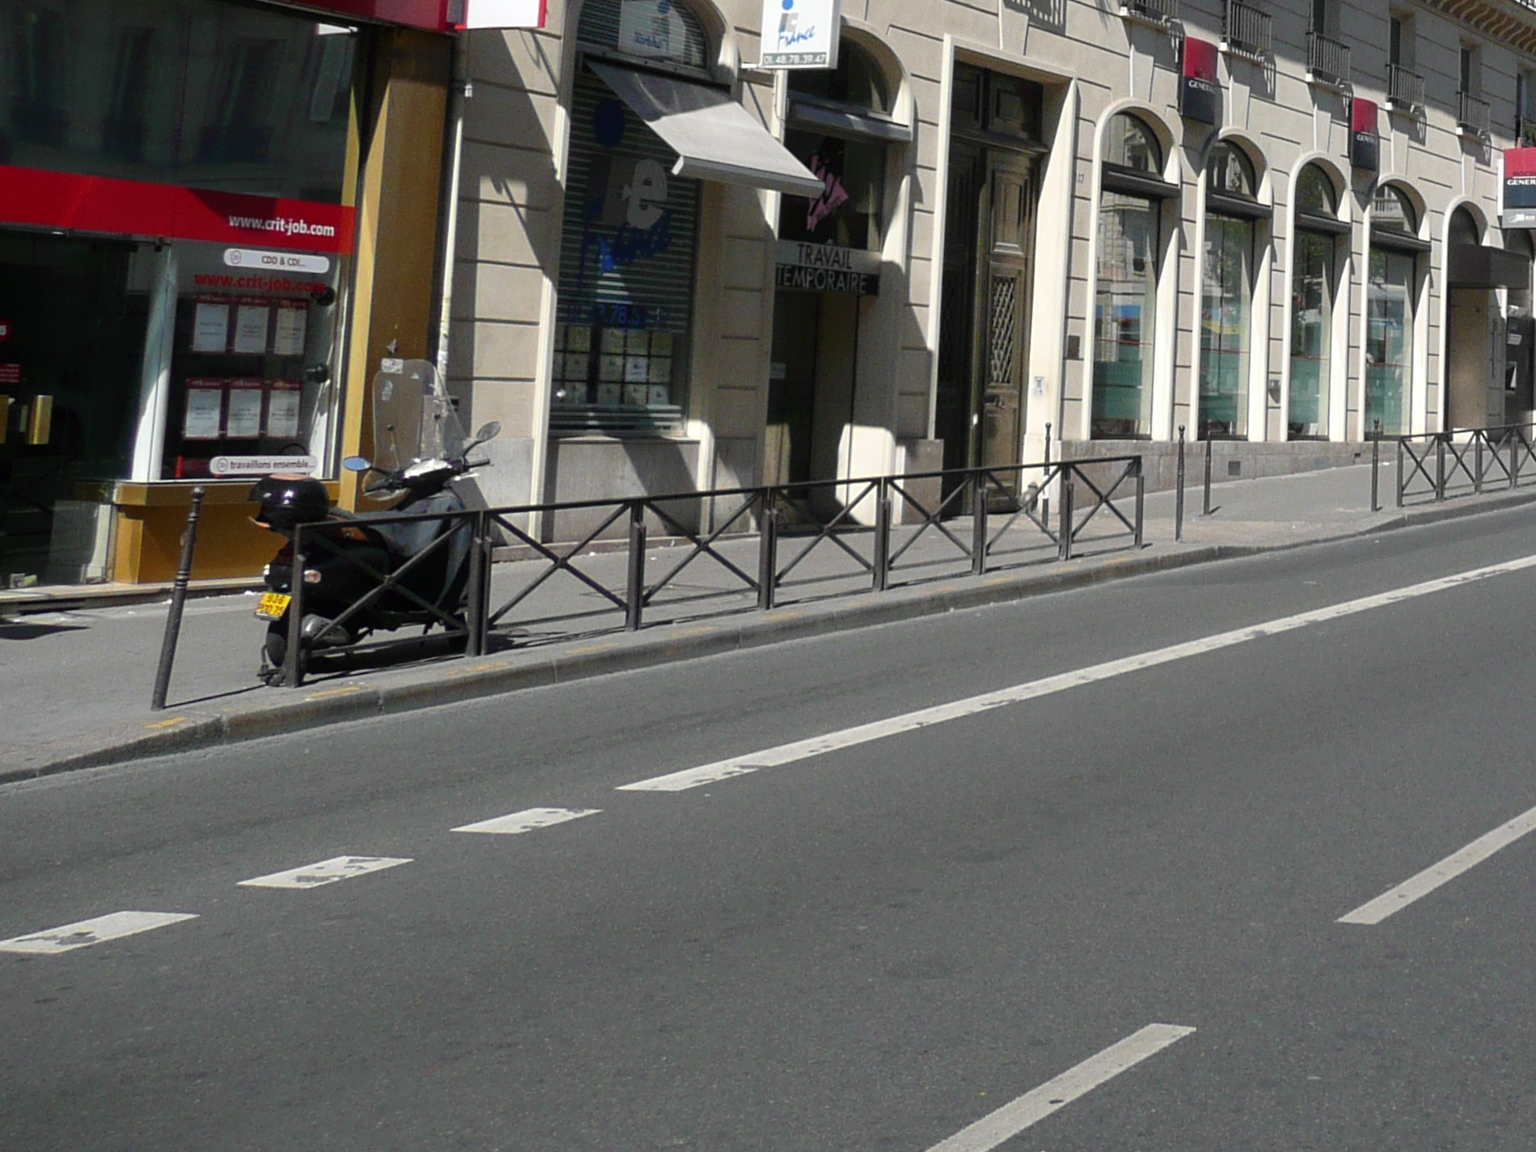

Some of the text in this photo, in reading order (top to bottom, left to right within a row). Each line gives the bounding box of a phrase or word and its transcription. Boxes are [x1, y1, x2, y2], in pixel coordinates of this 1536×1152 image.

[228, 215, 335, 237] www.crit-job.com
[799, 244, 852, 269] TRAVAIL
[194, 273, 326, 295] www.crit-job.com
[776, 265, 867, 294] TEMPORAIRE
[230, 460, 272, 469] travaillons
